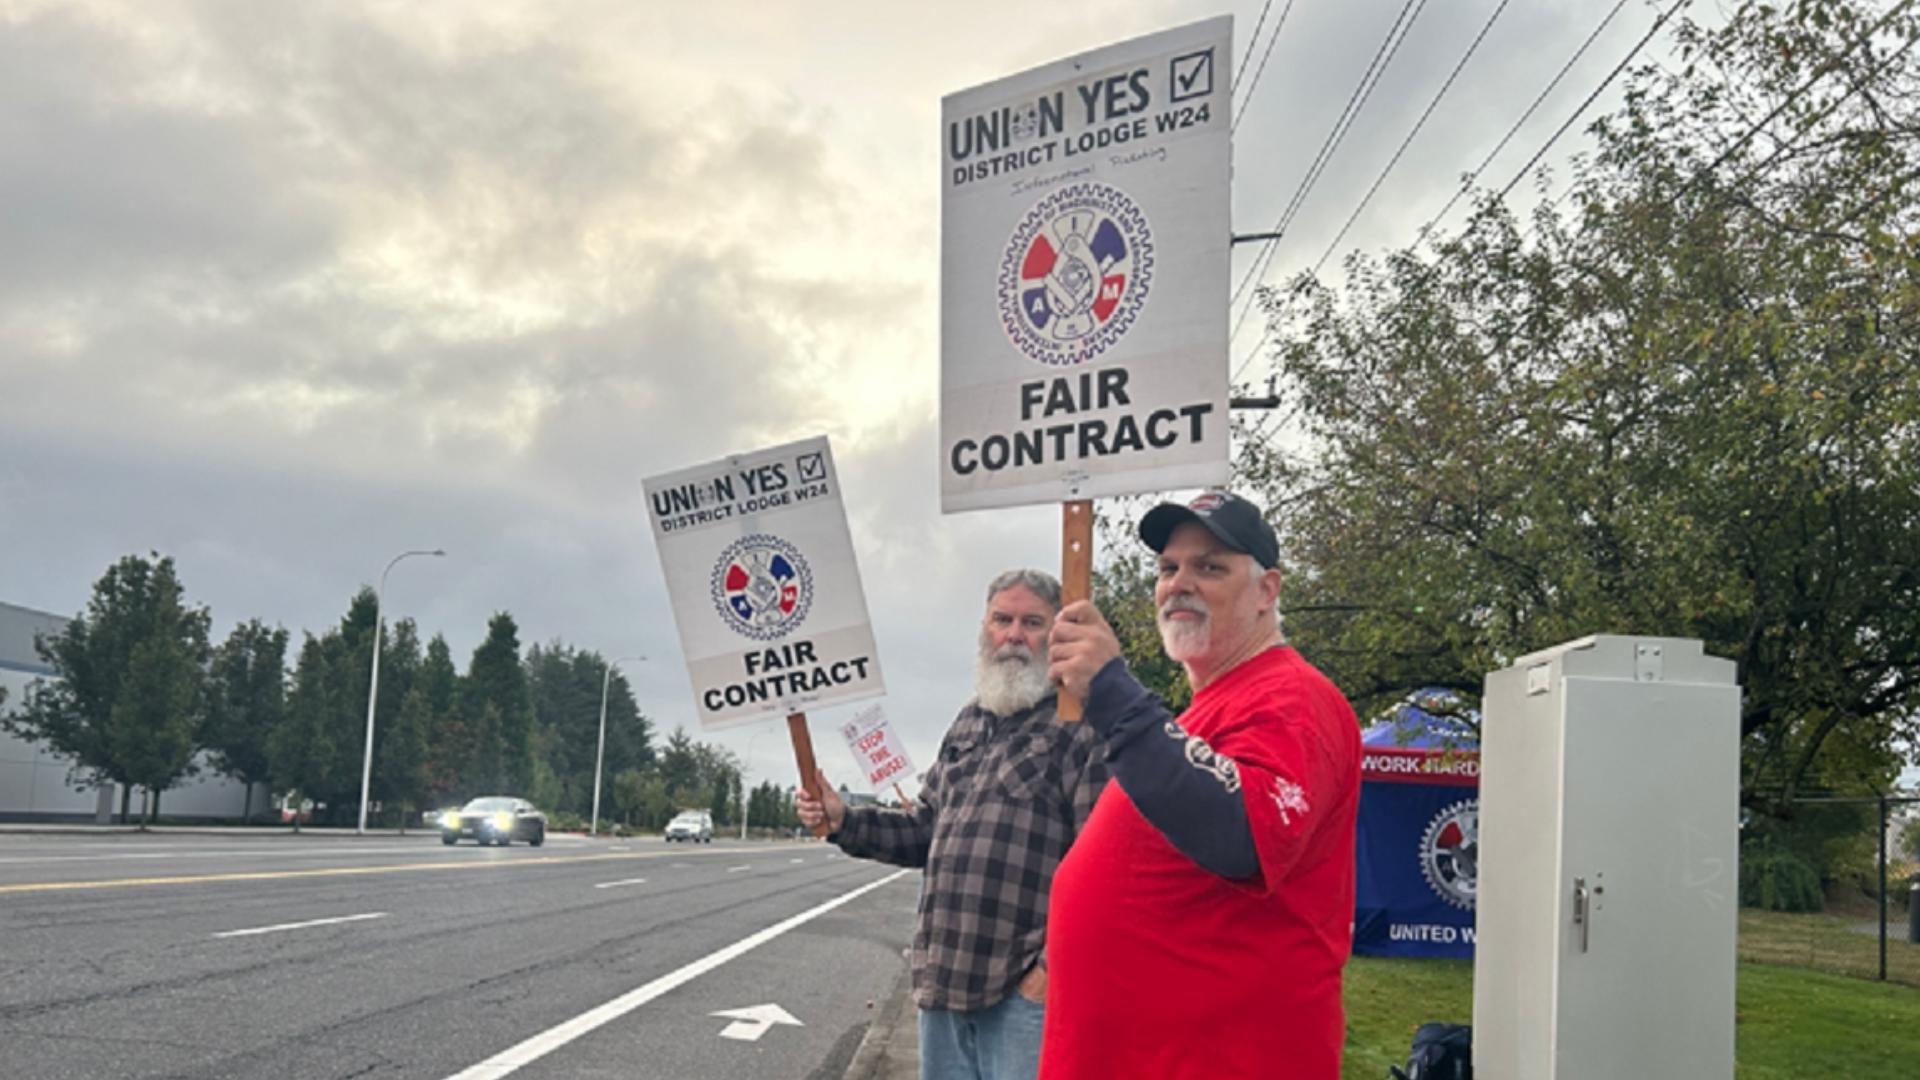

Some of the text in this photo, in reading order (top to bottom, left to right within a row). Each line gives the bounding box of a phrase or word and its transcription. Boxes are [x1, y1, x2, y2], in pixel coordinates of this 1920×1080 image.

[951, 68, 1150, 162] UNION YES
[953, 103, 1210, 186] DISTRICT LODGE W24
[1021, 367, 1131, 421] FAIR
[951, 403, 1213, 475] CONTRACT
[651, 463, 788, 517] UNION YES
[661, 483, 829, 532] DISTRICT LODGE W24
[704, 656, 869, 711] CONTRACT
[744, 640, 818, 676] FAIR
[858, 729, 885, 753] STOP
[870, 745, 892, 764] THE
[1361, 755, 1480, 777] WORK HARD
[1389, 923, 1457, 943] UNITED
